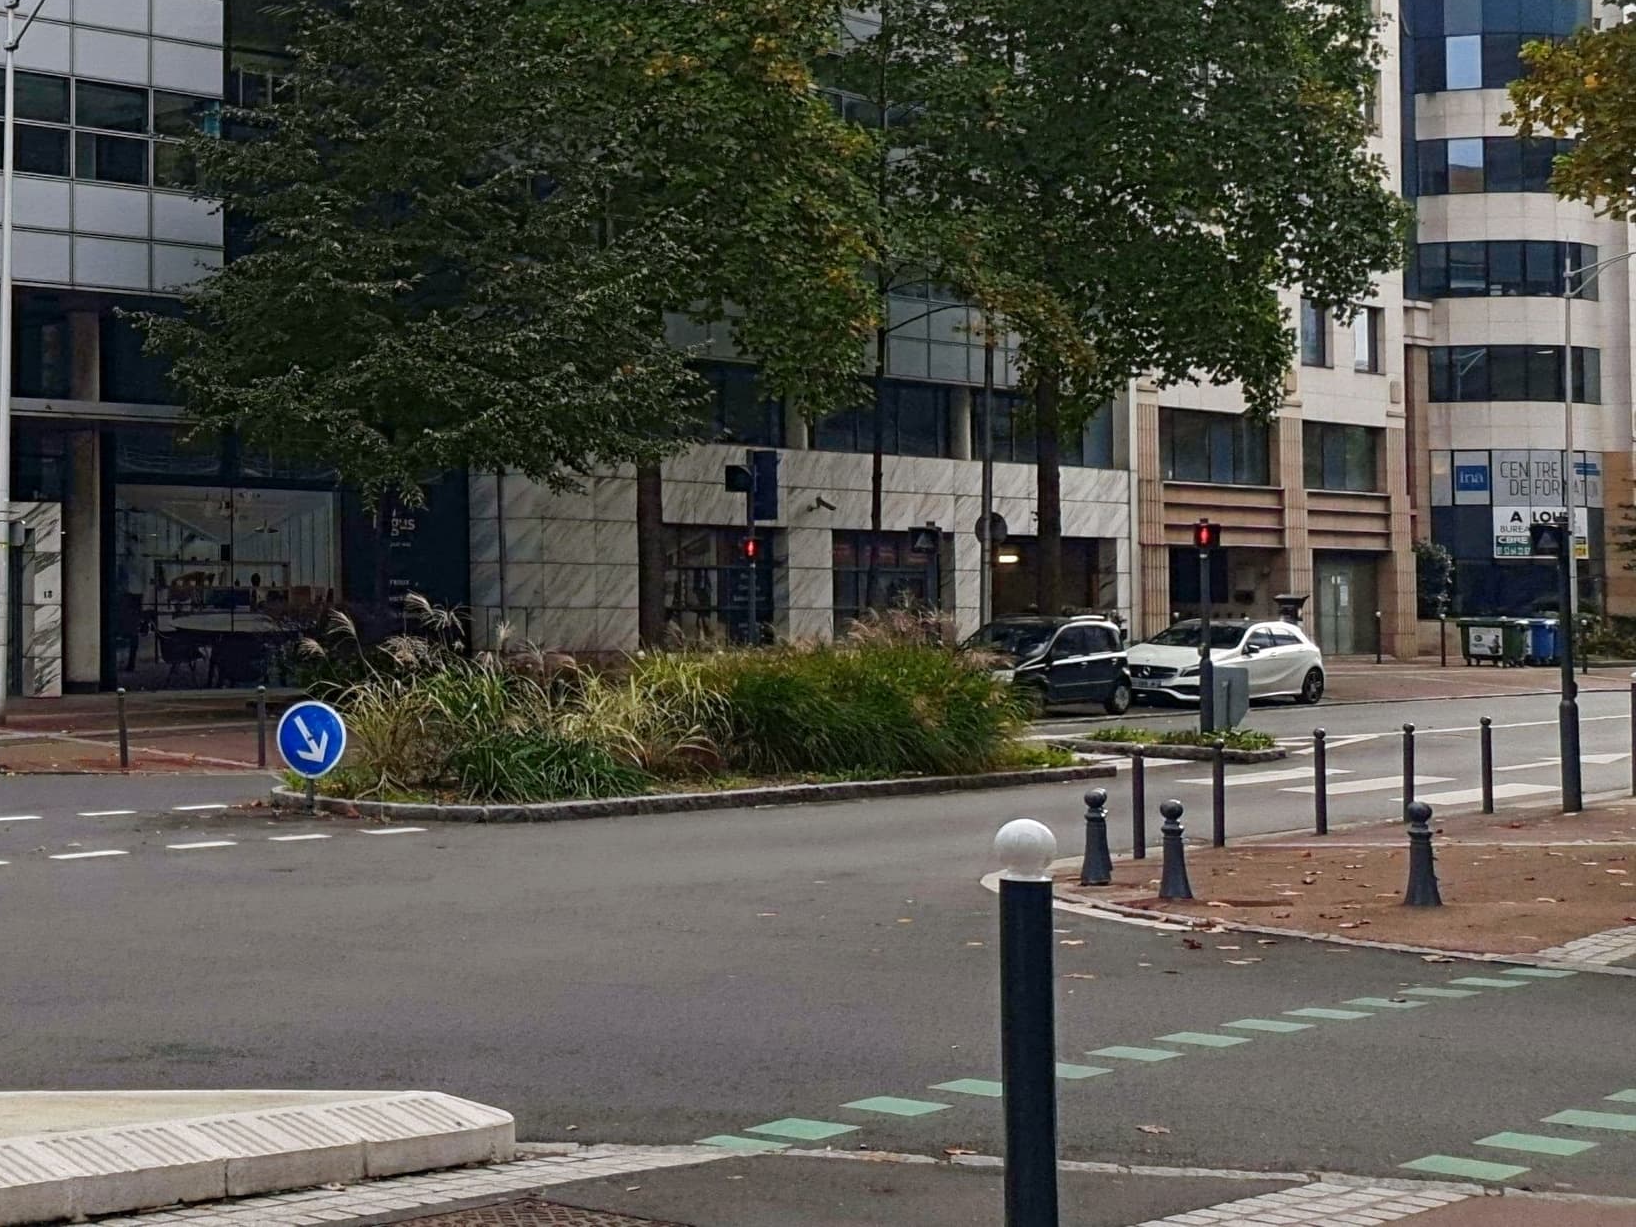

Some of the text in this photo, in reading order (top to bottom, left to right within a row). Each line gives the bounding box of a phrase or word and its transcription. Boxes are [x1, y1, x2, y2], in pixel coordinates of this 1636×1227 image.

[1500, 461, 1559, 479] CENTRE
[1509, 479, 1529, 496] DE
[1510, 510, 1523, 523] A
